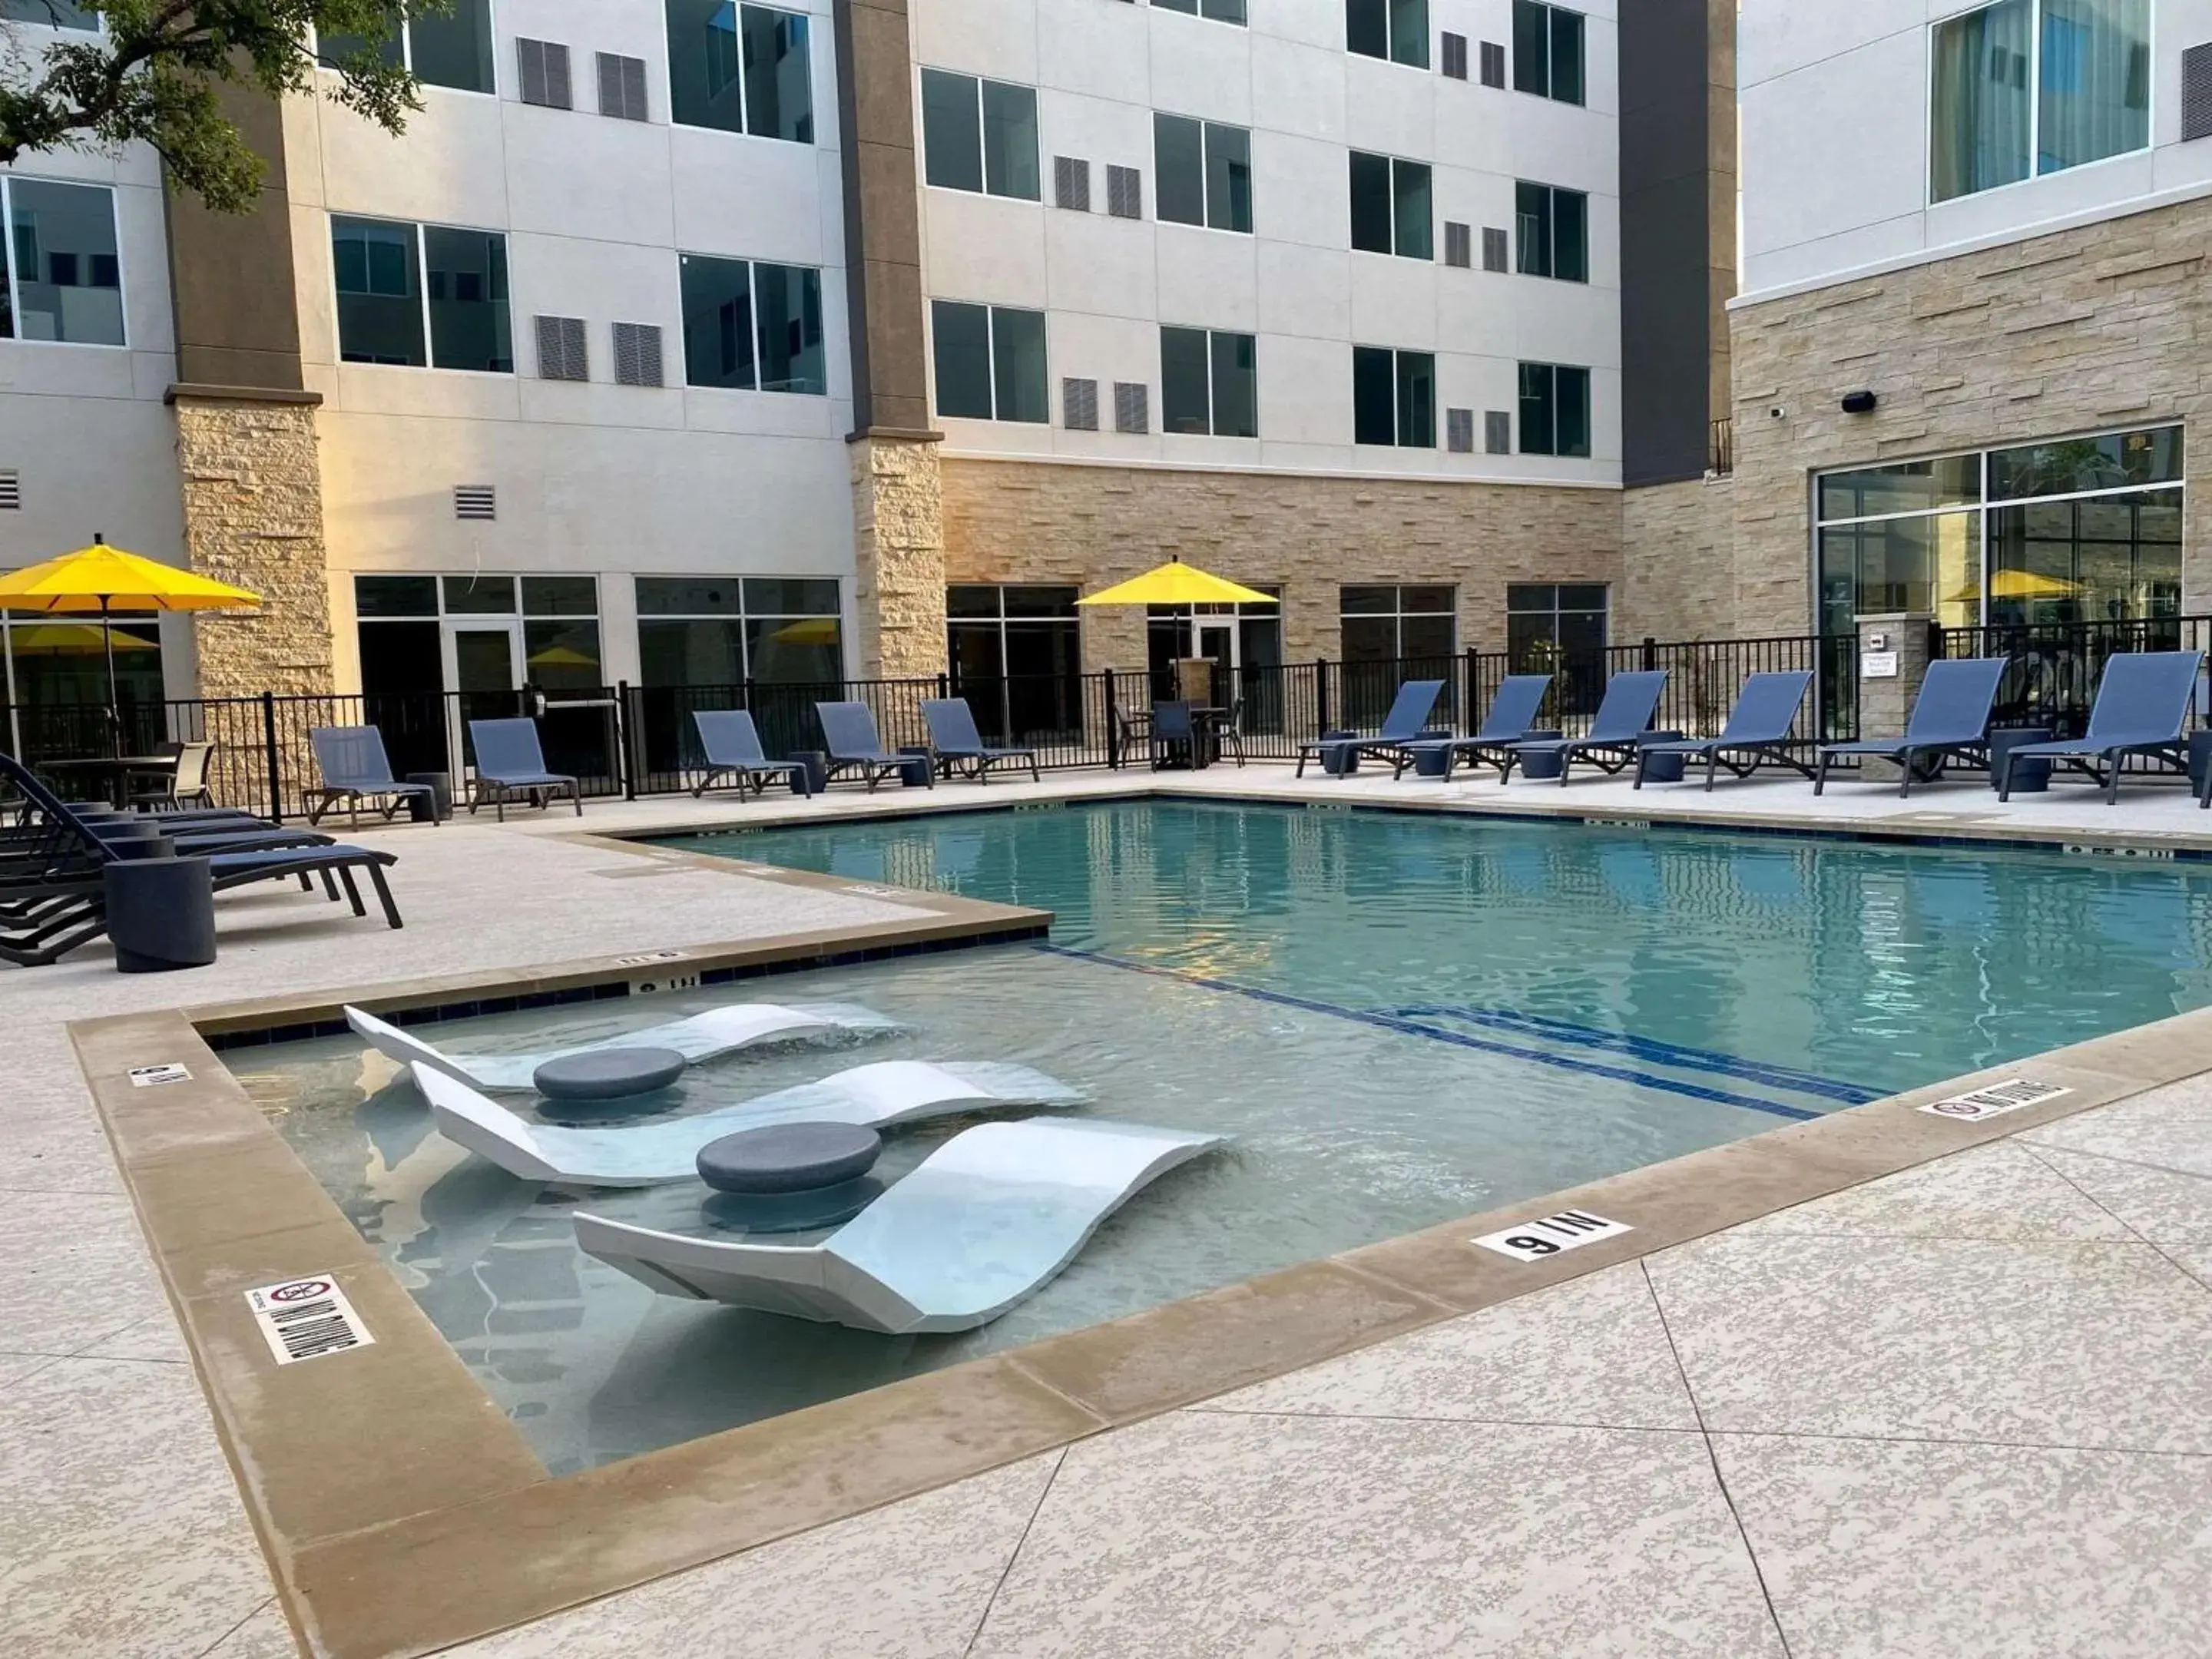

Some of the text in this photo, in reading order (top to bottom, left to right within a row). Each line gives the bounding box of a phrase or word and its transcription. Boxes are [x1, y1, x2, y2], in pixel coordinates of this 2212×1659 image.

[1505, 1211, 1610, 1254] 9 IN
[270, 1298, 359, 1359] NO DIVING
